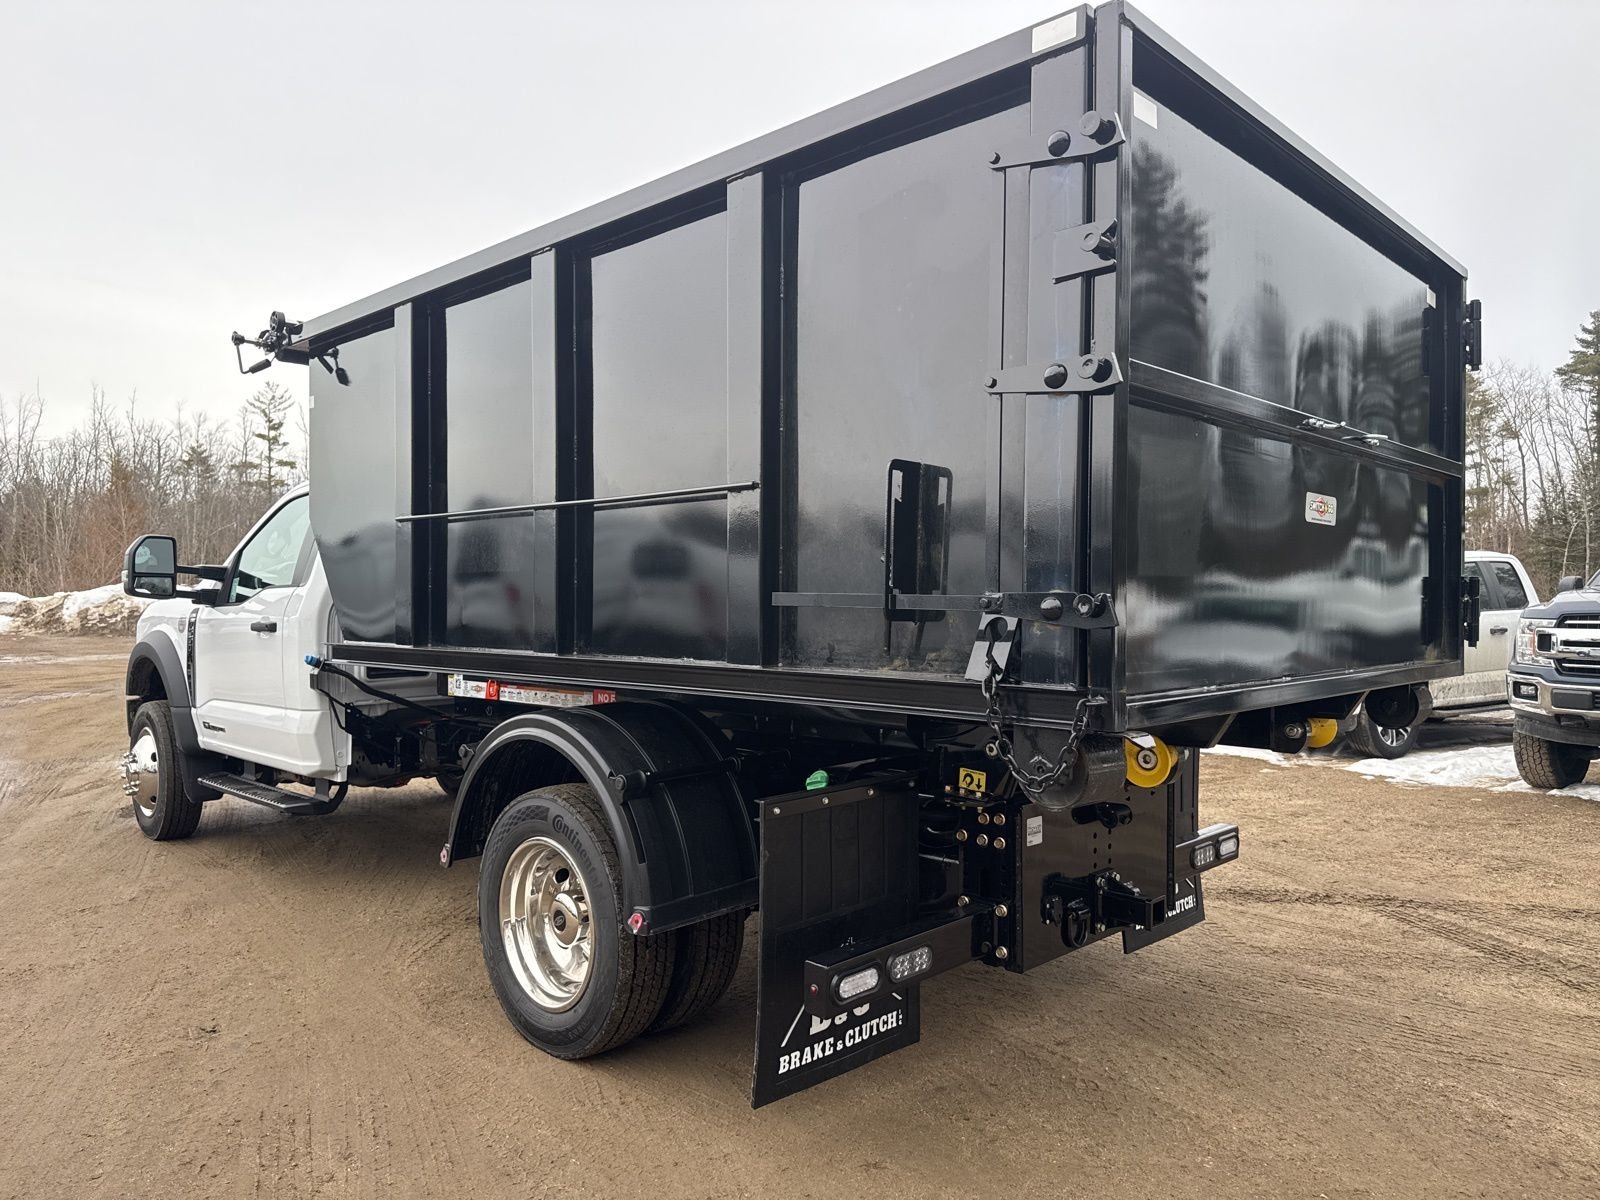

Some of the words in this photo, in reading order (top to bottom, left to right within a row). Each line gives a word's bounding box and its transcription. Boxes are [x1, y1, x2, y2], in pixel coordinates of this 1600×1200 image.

[597, 693, 609, 703] NO
[778, 1037, 834, 1075] BRAKE
[836, 1040, 843, 1051] &
[845, 1010, 897, 1048] CLUTCH
